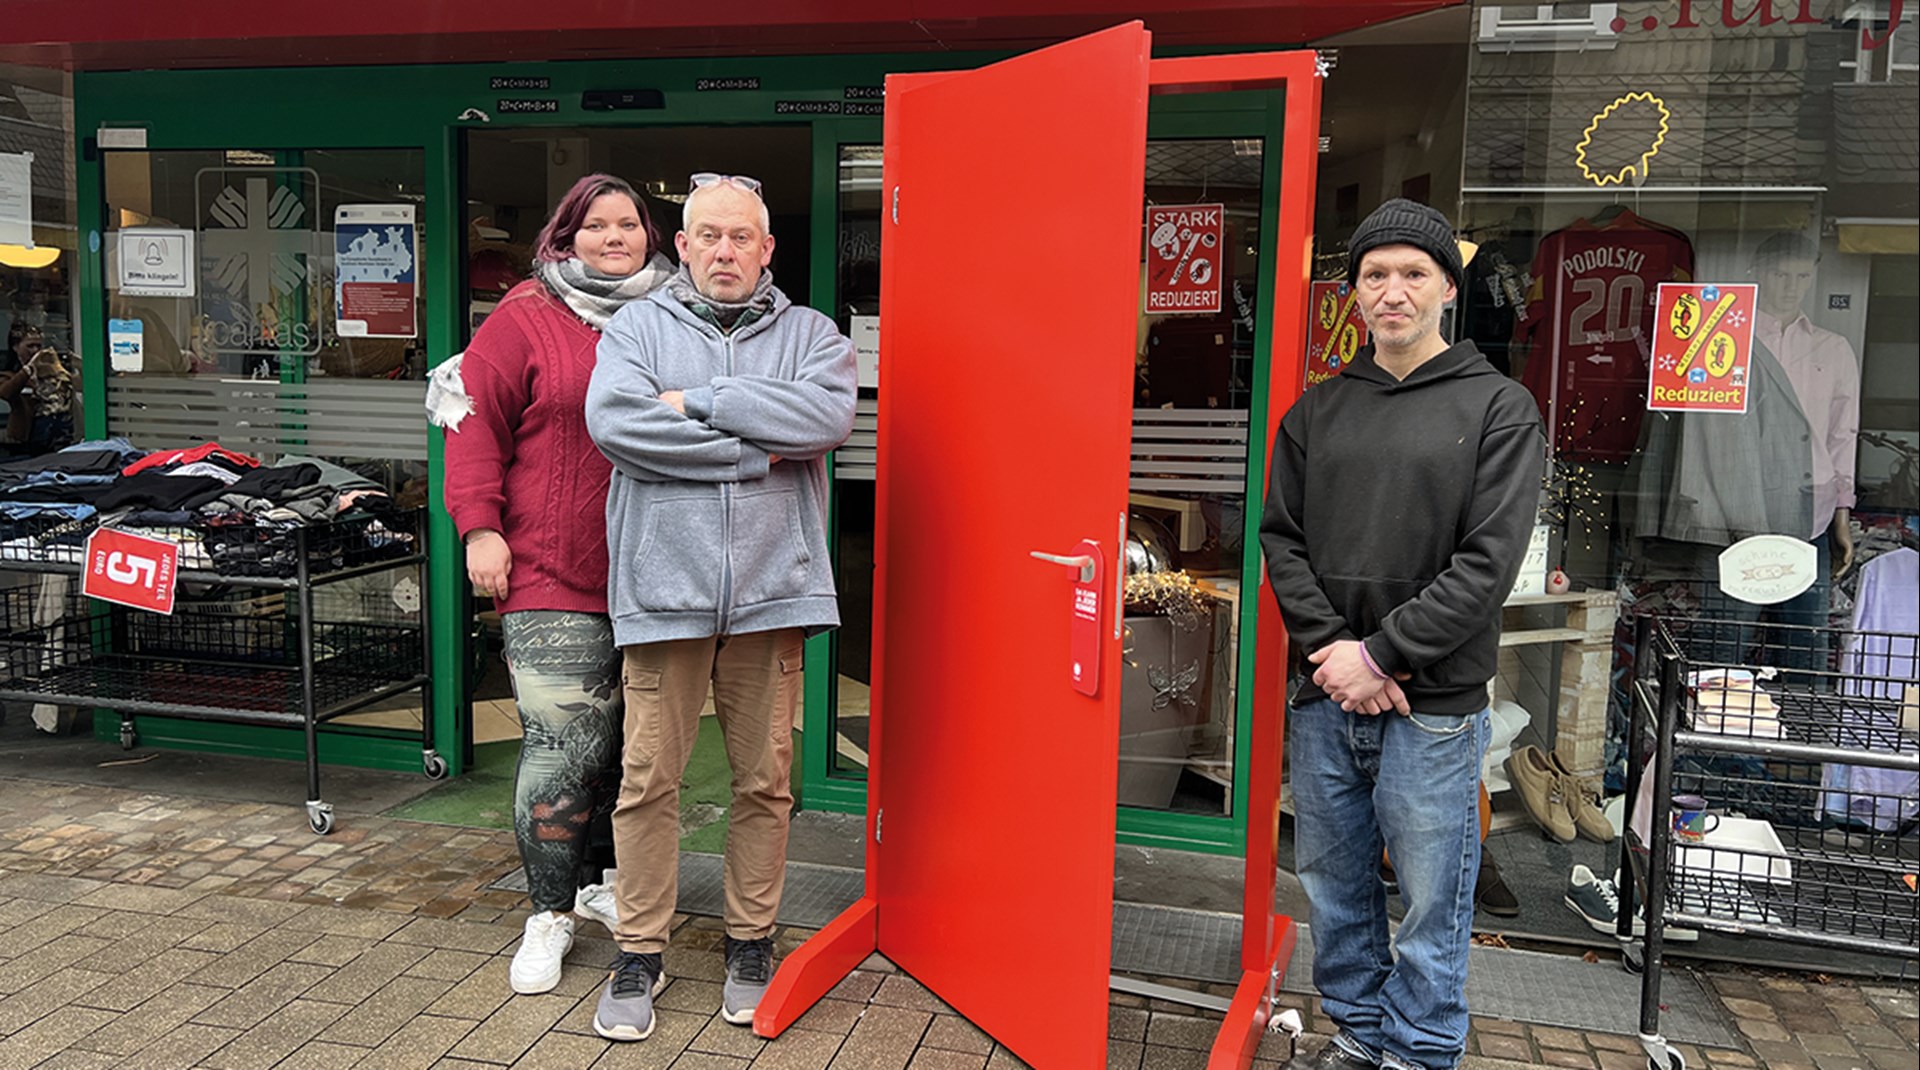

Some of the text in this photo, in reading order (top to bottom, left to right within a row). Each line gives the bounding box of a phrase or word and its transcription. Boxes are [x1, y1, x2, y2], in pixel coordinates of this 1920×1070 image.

[1154, 210, 1217, 227] STARK
[1562, 247, 1646, 279] PODOLSKI
[1150, 290, 1217, 307] REDUZIERT
[1568, 274, 1645, 346] 20
[1654, 386, 1741, 403] Reduziert
[94, 550, 107, 575] EURO
[107, 551, 157, 588] 5
